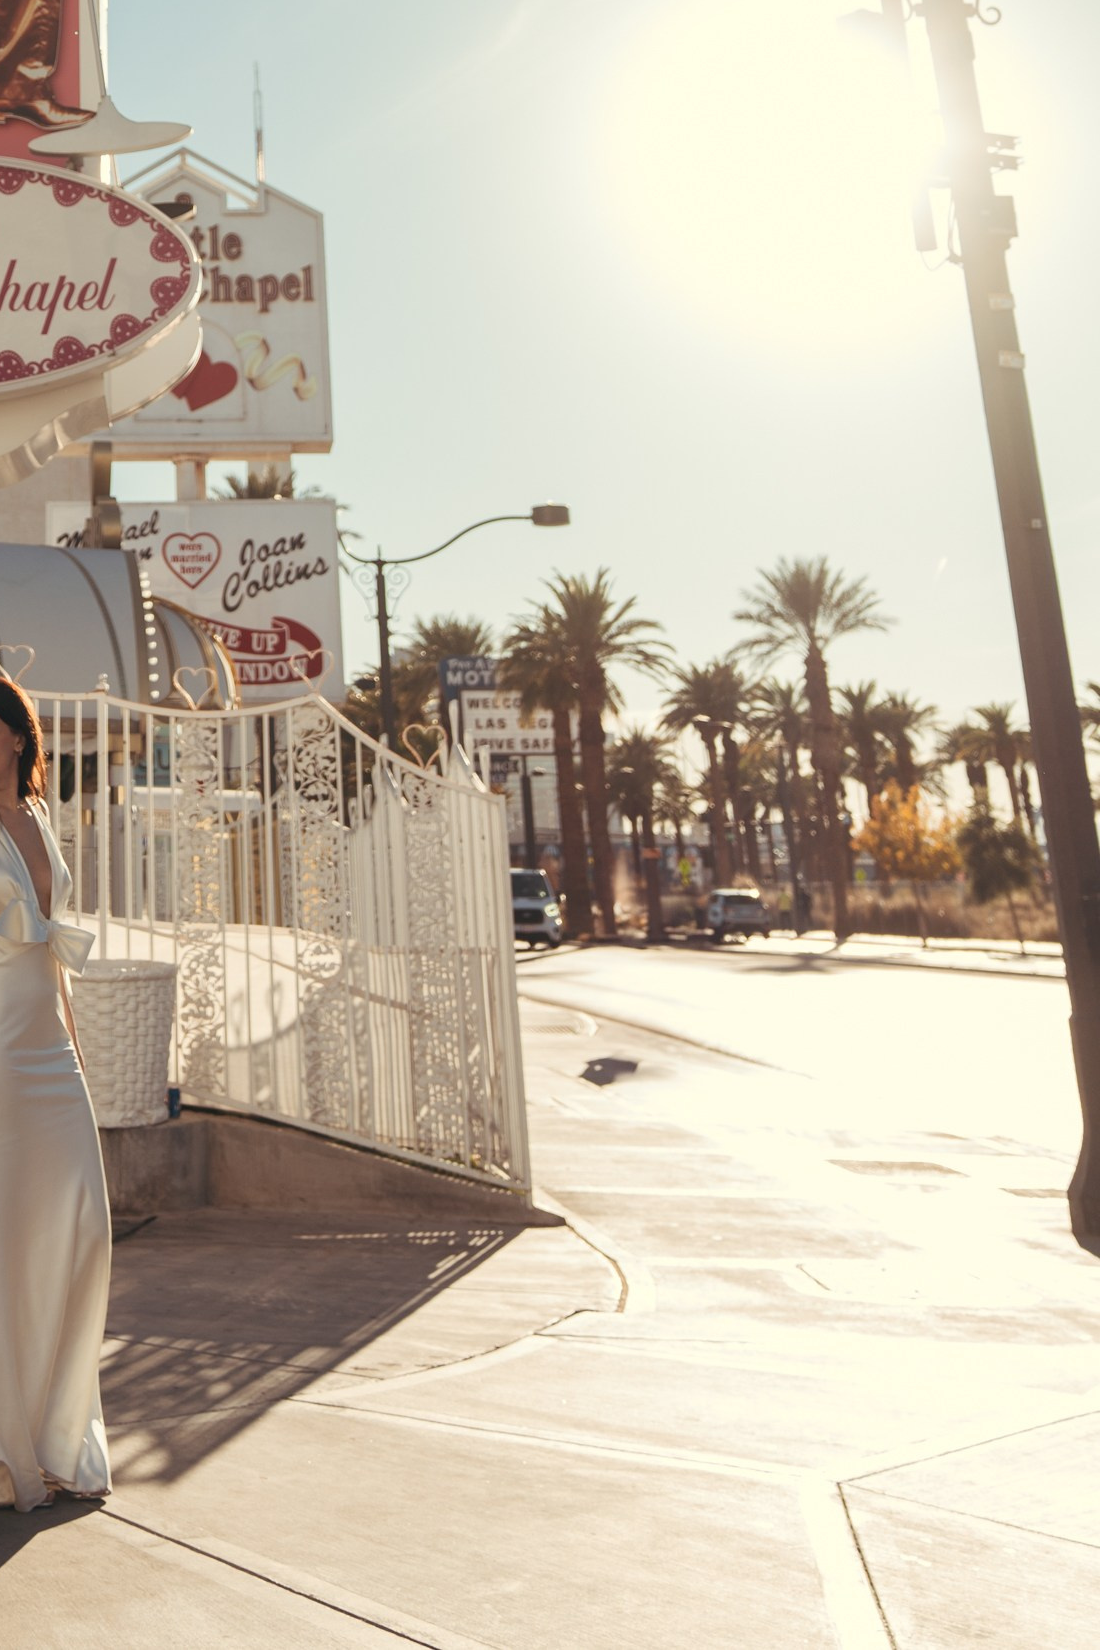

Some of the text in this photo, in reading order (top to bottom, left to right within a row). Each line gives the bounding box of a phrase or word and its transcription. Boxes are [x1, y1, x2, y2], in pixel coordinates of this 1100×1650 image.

[199, 264, 315, 314] hapel
[178, 543, 203, 552] were
[171, 553, 212, 564] married
[239, 532, 307, 581] Joan
[180, 564, 203, 575] here
[222, 556, 330, 613] Collins
[251, 632, 280, 652] UP
[235, 657, 309, 682] INDOW
[446, 670, 493, 685] MOT
[475, 718, 507, 729] LAS
